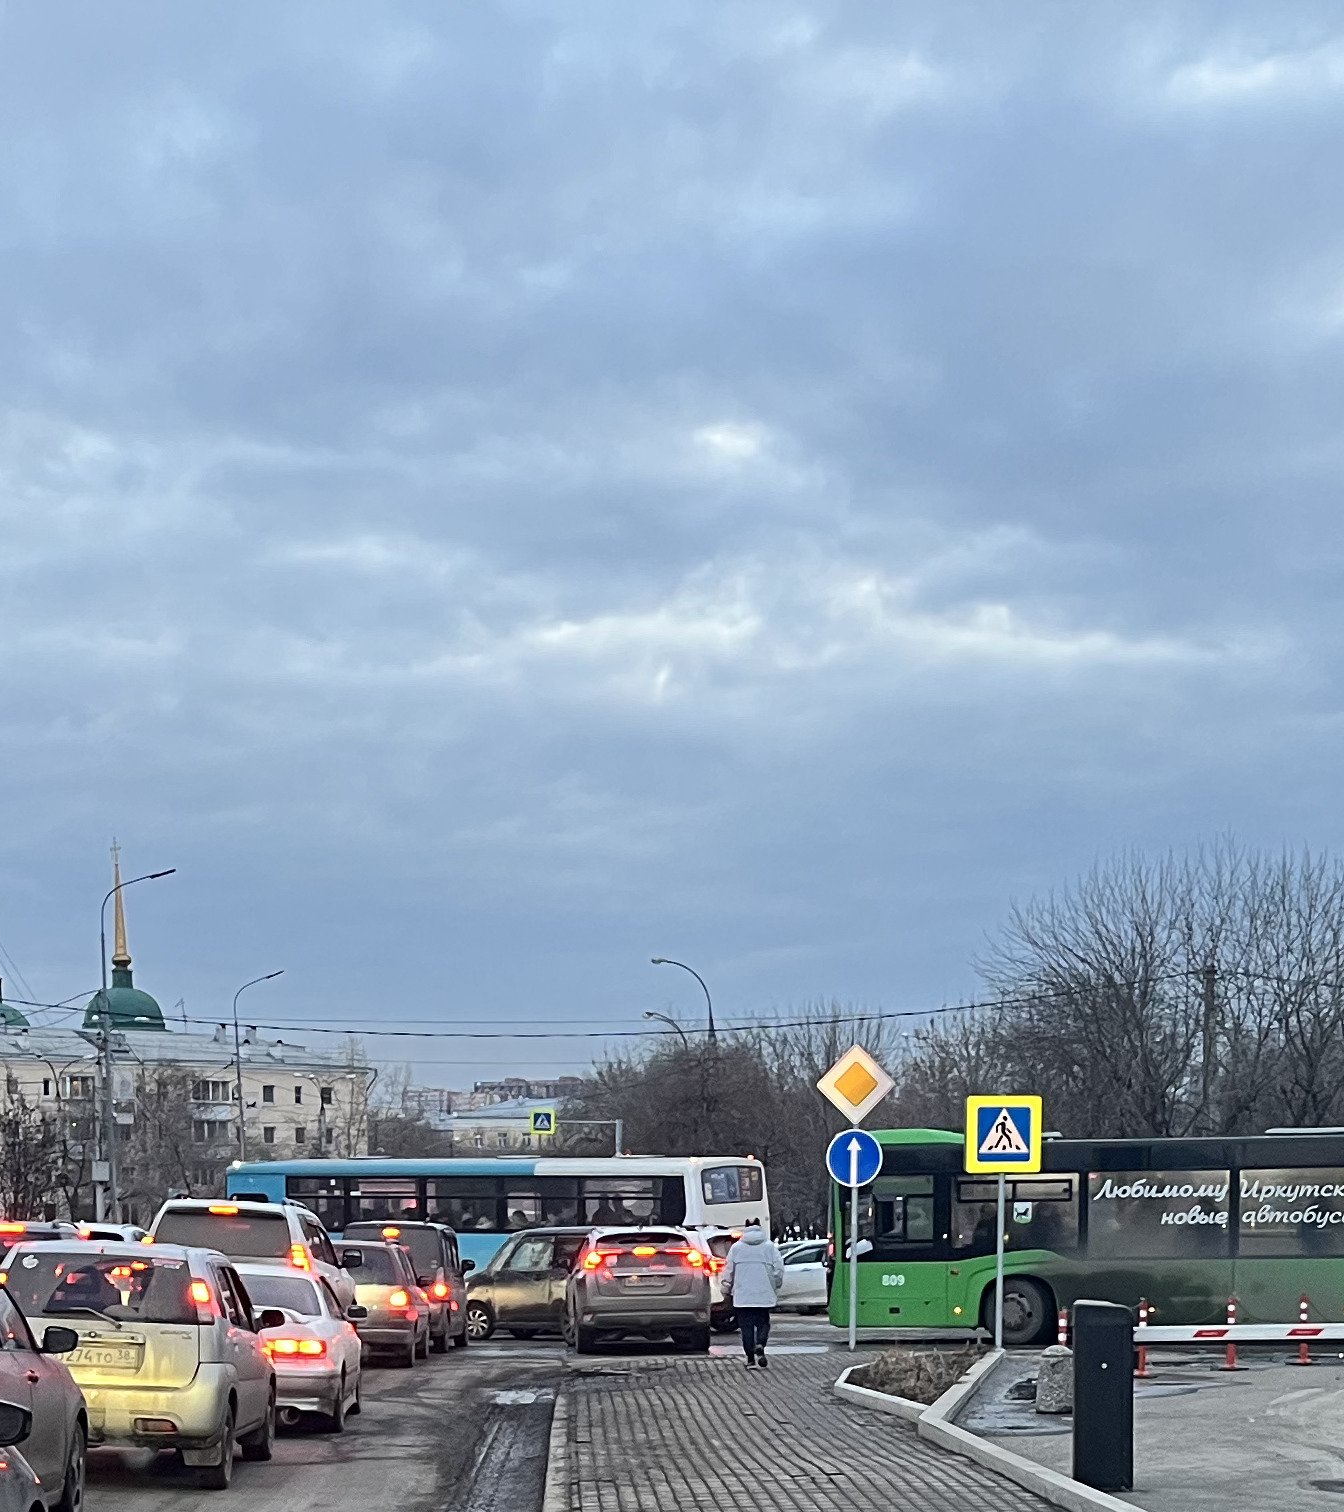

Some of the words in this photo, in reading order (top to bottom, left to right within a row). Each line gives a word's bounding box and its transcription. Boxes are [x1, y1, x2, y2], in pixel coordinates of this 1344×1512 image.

[1093, 1179, 1229, 1201] Любимому
[1160, 1205, 1229, 1225] новые
[881, 1274, 905, 1286] 809
